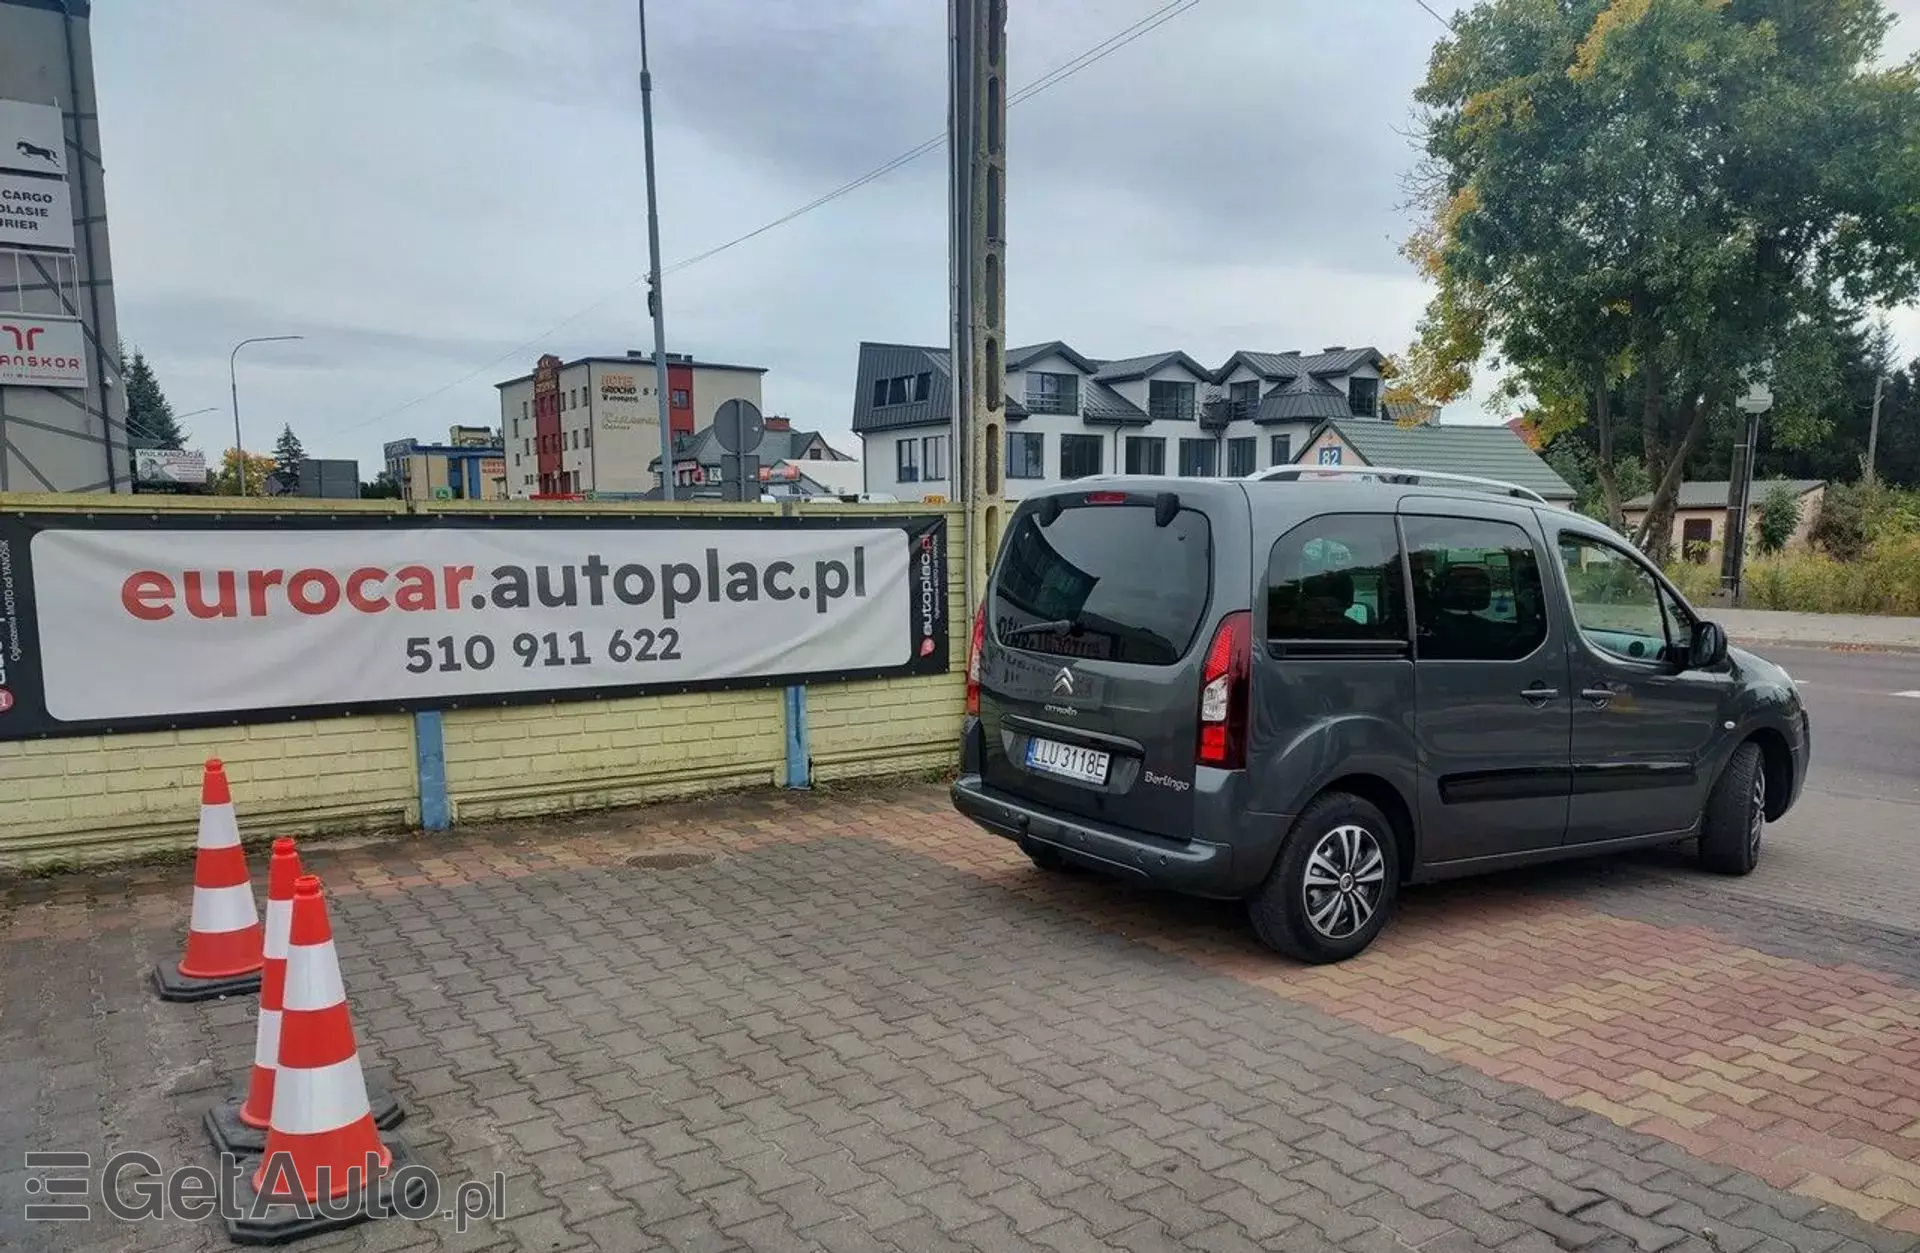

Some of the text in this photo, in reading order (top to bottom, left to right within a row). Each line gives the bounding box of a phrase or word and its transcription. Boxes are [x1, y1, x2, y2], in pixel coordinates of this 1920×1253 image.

[2, 190, 52, 203] CARGO
[1322, 450, 1339, 467] 82
[121, 546, 866, 620] eurocar.autoplac.pl
[920, 533, 933, 636] autoplac.pl
[4, 589, 15, 615] MOTO
[405, 627, 682, 674] 510 911 622
[1062, 747, 1106, 777] 3118E
[1144, 771, 1190, 791] Berlingo
